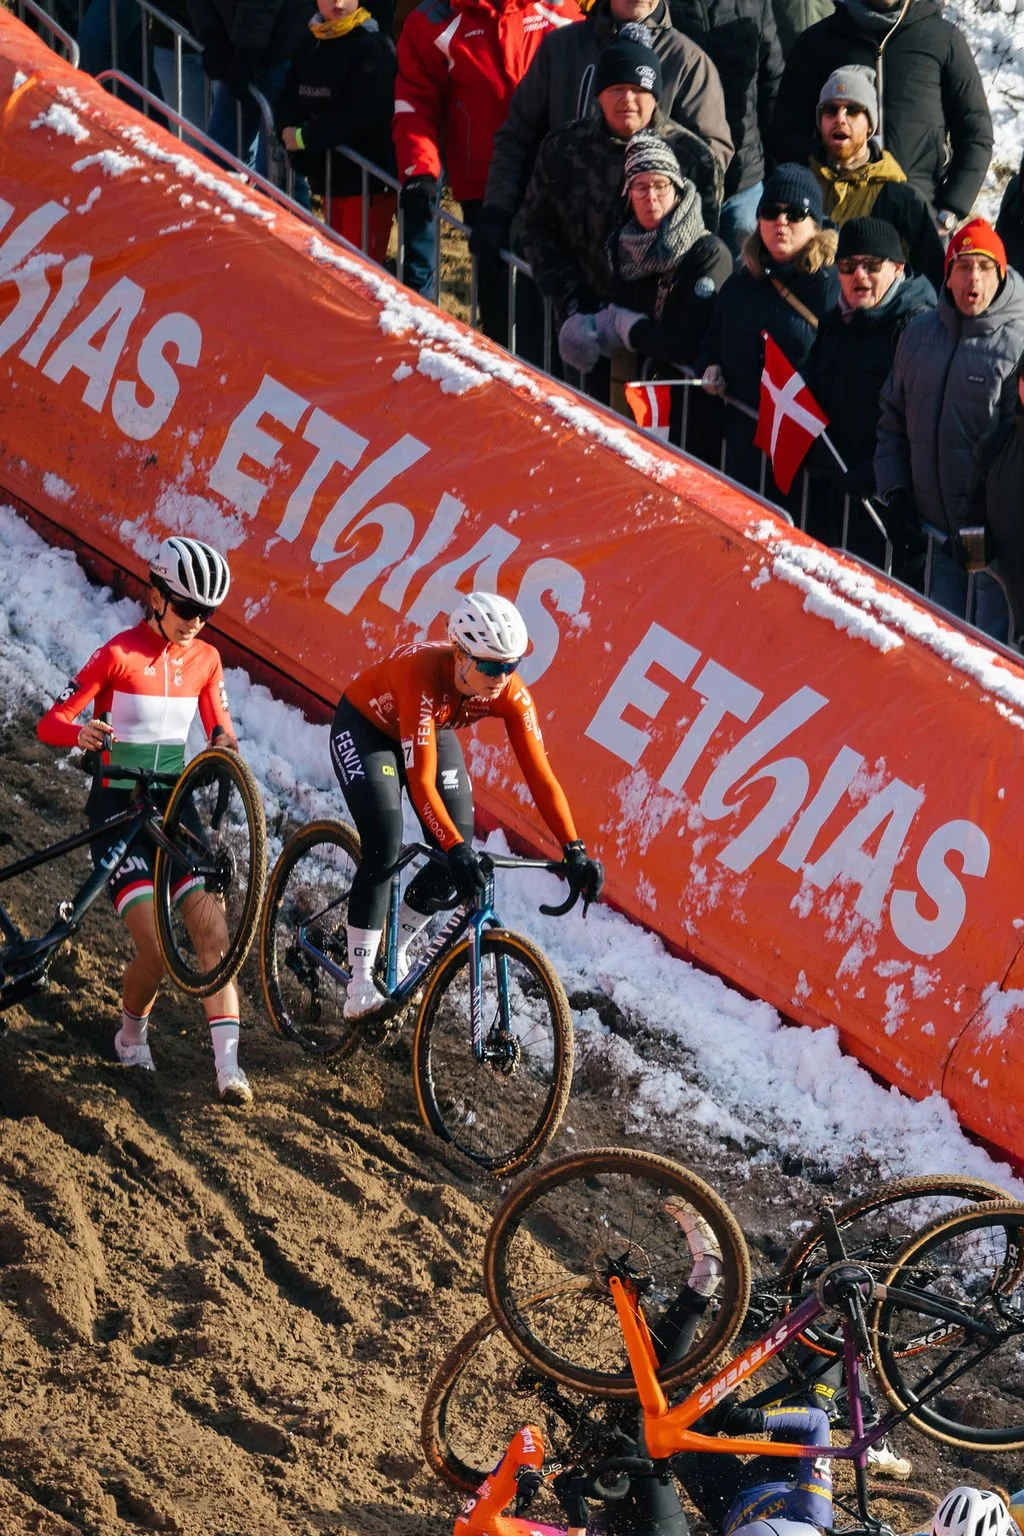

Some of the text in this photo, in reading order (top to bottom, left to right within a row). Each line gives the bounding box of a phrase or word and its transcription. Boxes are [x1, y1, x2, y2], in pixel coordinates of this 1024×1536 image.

[0, 201, 203, 442] HIAS
[417, 691, 434, 746] FENIX
[335, 730, 366, 781] FENIX
[699, 1325, 789, 1410] STEVENS
